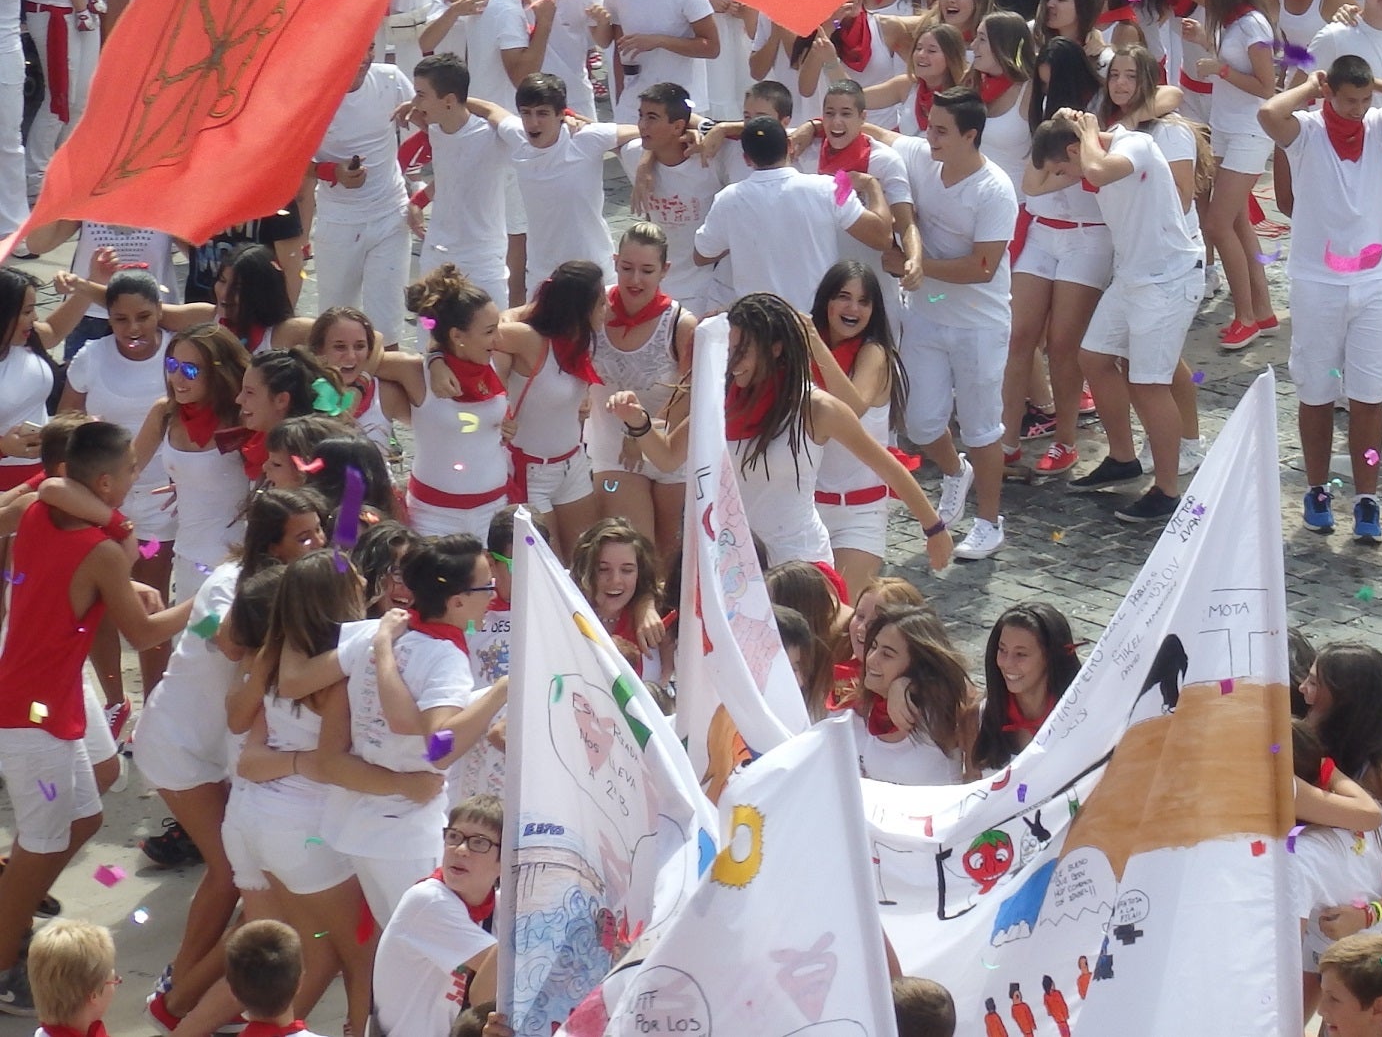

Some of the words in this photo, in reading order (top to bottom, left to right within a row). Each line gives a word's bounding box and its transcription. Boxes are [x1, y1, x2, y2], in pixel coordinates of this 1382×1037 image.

[1208, 602, 1250, 618] MOTA
[1113, 634, 1145, 667] MIKEL
[667, 1016, 701, 1032] LOS
